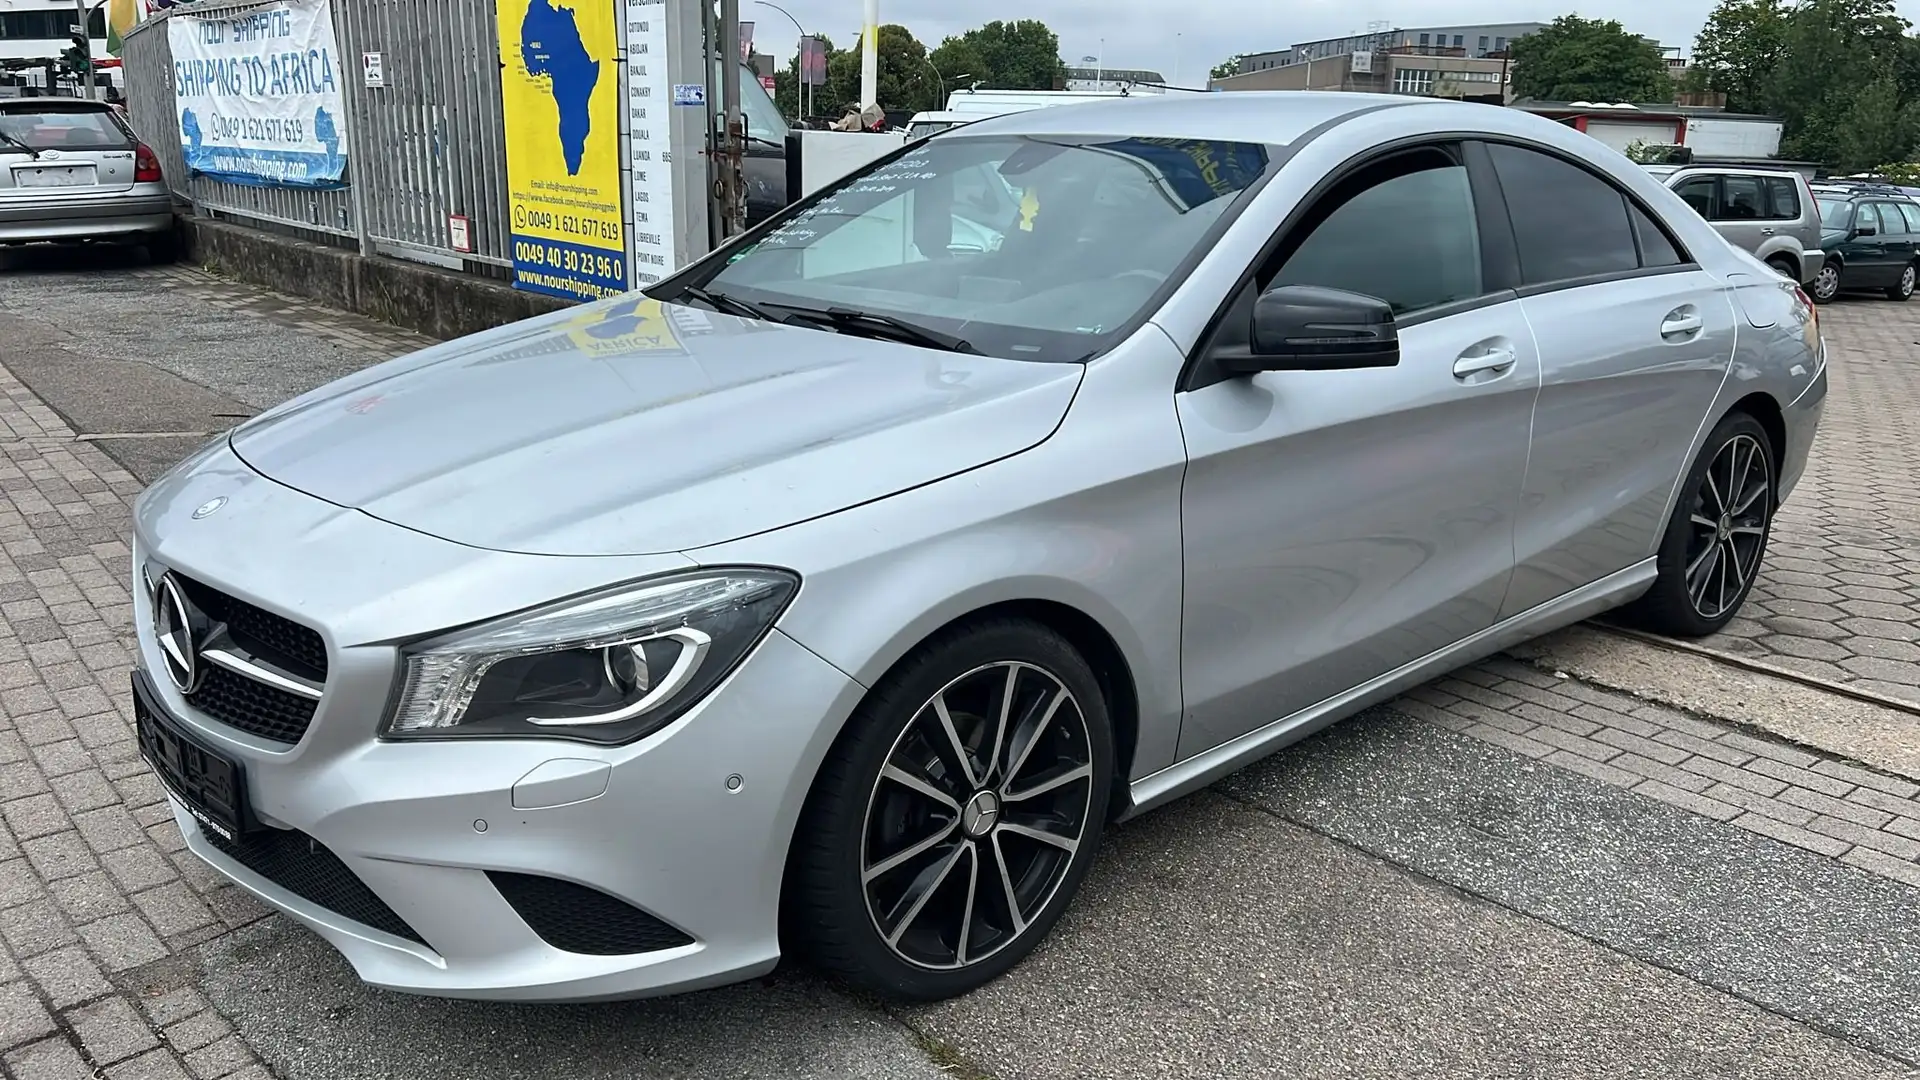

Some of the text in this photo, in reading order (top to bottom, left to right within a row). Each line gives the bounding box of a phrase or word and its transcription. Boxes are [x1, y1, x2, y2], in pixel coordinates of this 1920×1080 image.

[175, 48, 336, 97] SHIPPING TO AFRICA
[241, 118, 248, 140] 1
[249, 118, 265, 140] 621
[265, 117, 282, 141] 677
[284, 118, 303, 142] 619
[528, 210, 619, 241] 0049 1 621 677 619
[636, 211, 649, 223] TEMA
[515, 240, 622, 281] 0049 40 30 23 96 0
